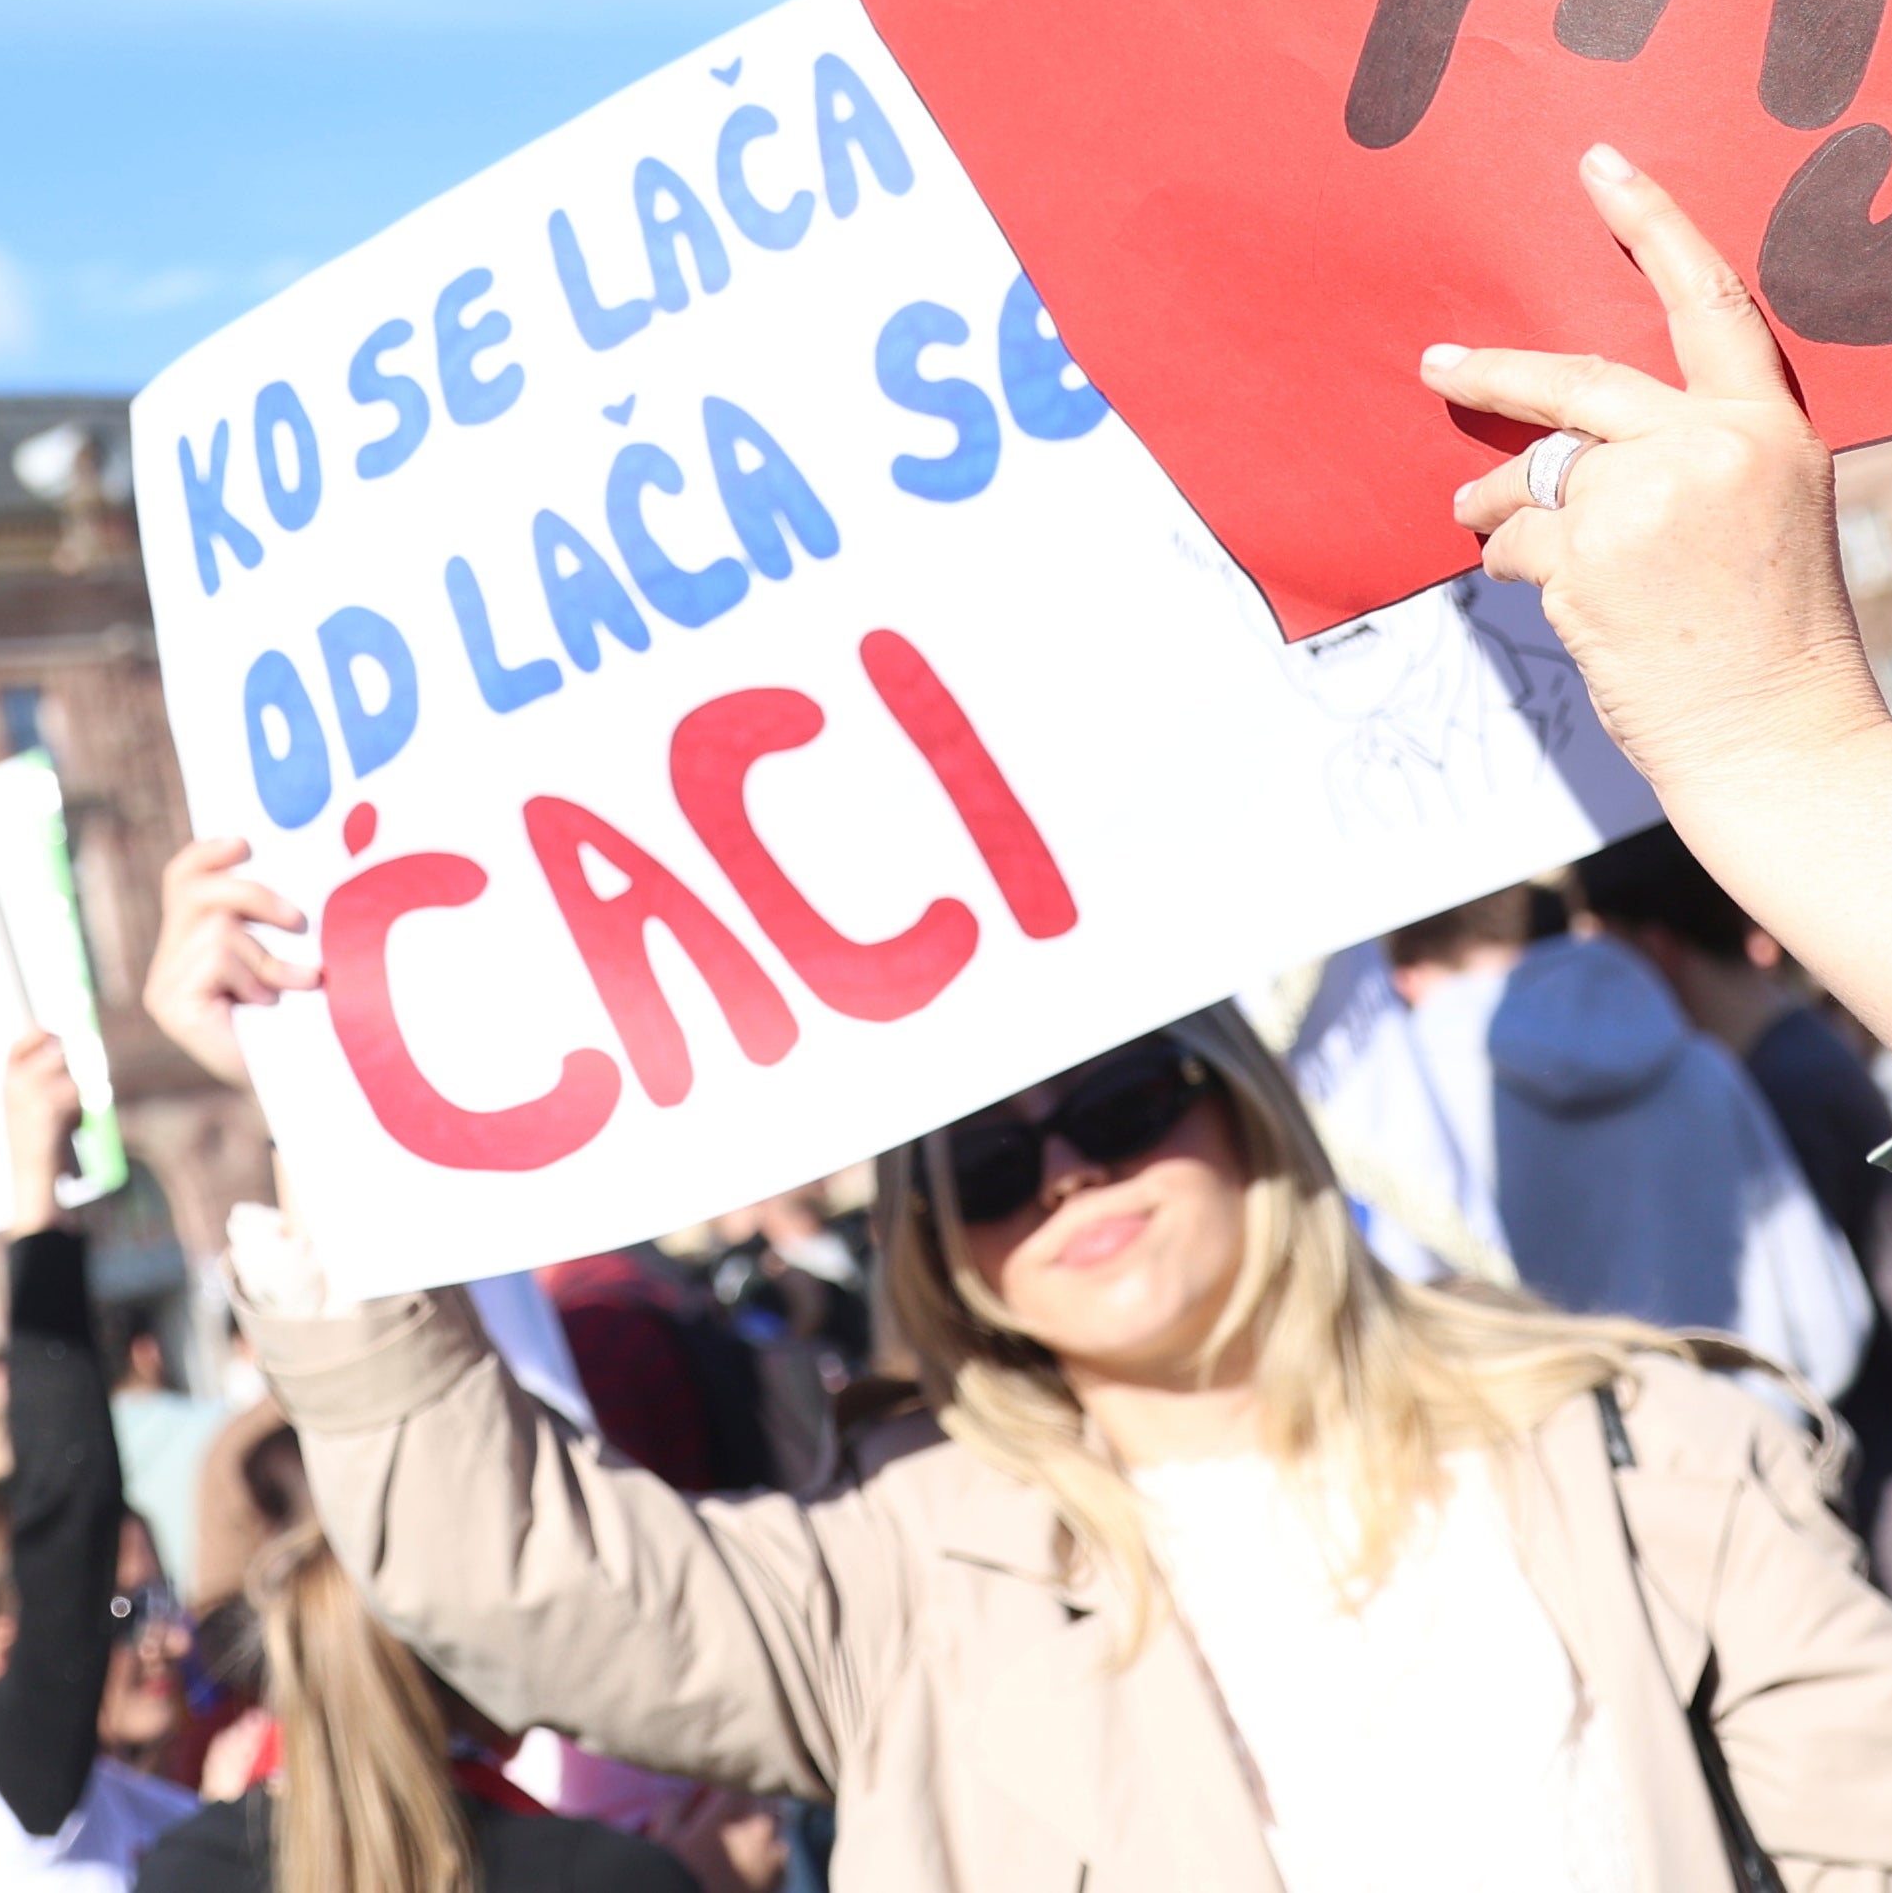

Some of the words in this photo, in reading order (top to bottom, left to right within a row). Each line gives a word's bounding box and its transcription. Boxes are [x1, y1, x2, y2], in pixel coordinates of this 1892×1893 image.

[176, 378, 323, 597] KO
[347, 266, 526, 481] SE
[547, 51, 916, 352] LAČA
[243, 604, 420, 831] OD
[443, 394, 842, 717] LAČA
[873, 267, 1111, 504] SE
[310, 627, 1079, 1173] ĆACI
